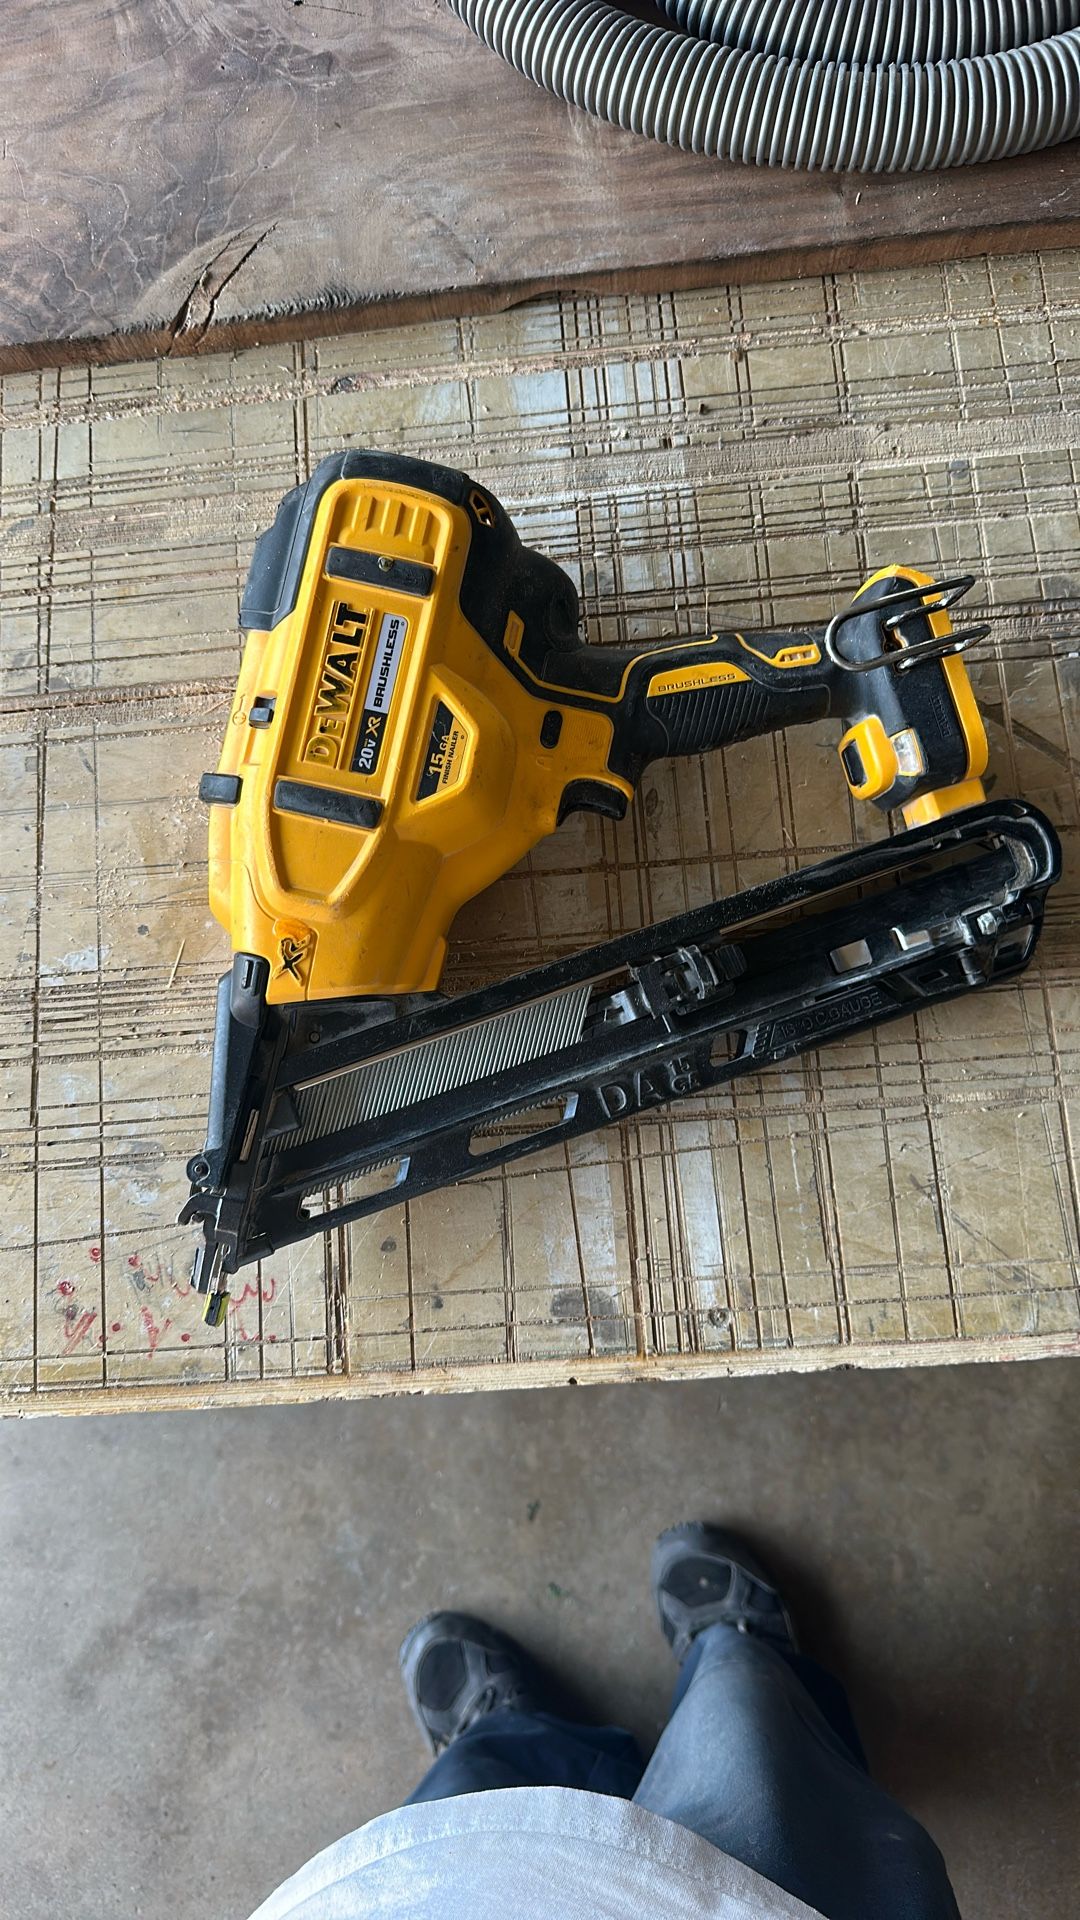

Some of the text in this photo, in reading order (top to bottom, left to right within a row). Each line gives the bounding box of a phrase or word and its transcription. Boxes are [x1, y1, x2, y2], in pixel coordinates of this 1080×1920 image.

[373, 618, 401, 708] BRUSHLESS
[657, 673, 736, 692] BRUSHLESS
[302, 601, 368, 769] DEWALT
[365, 715, 382, 738] XR
[428, 752, 445, 776] 15
[442, 730, 459, 784] FINISH NAILER
